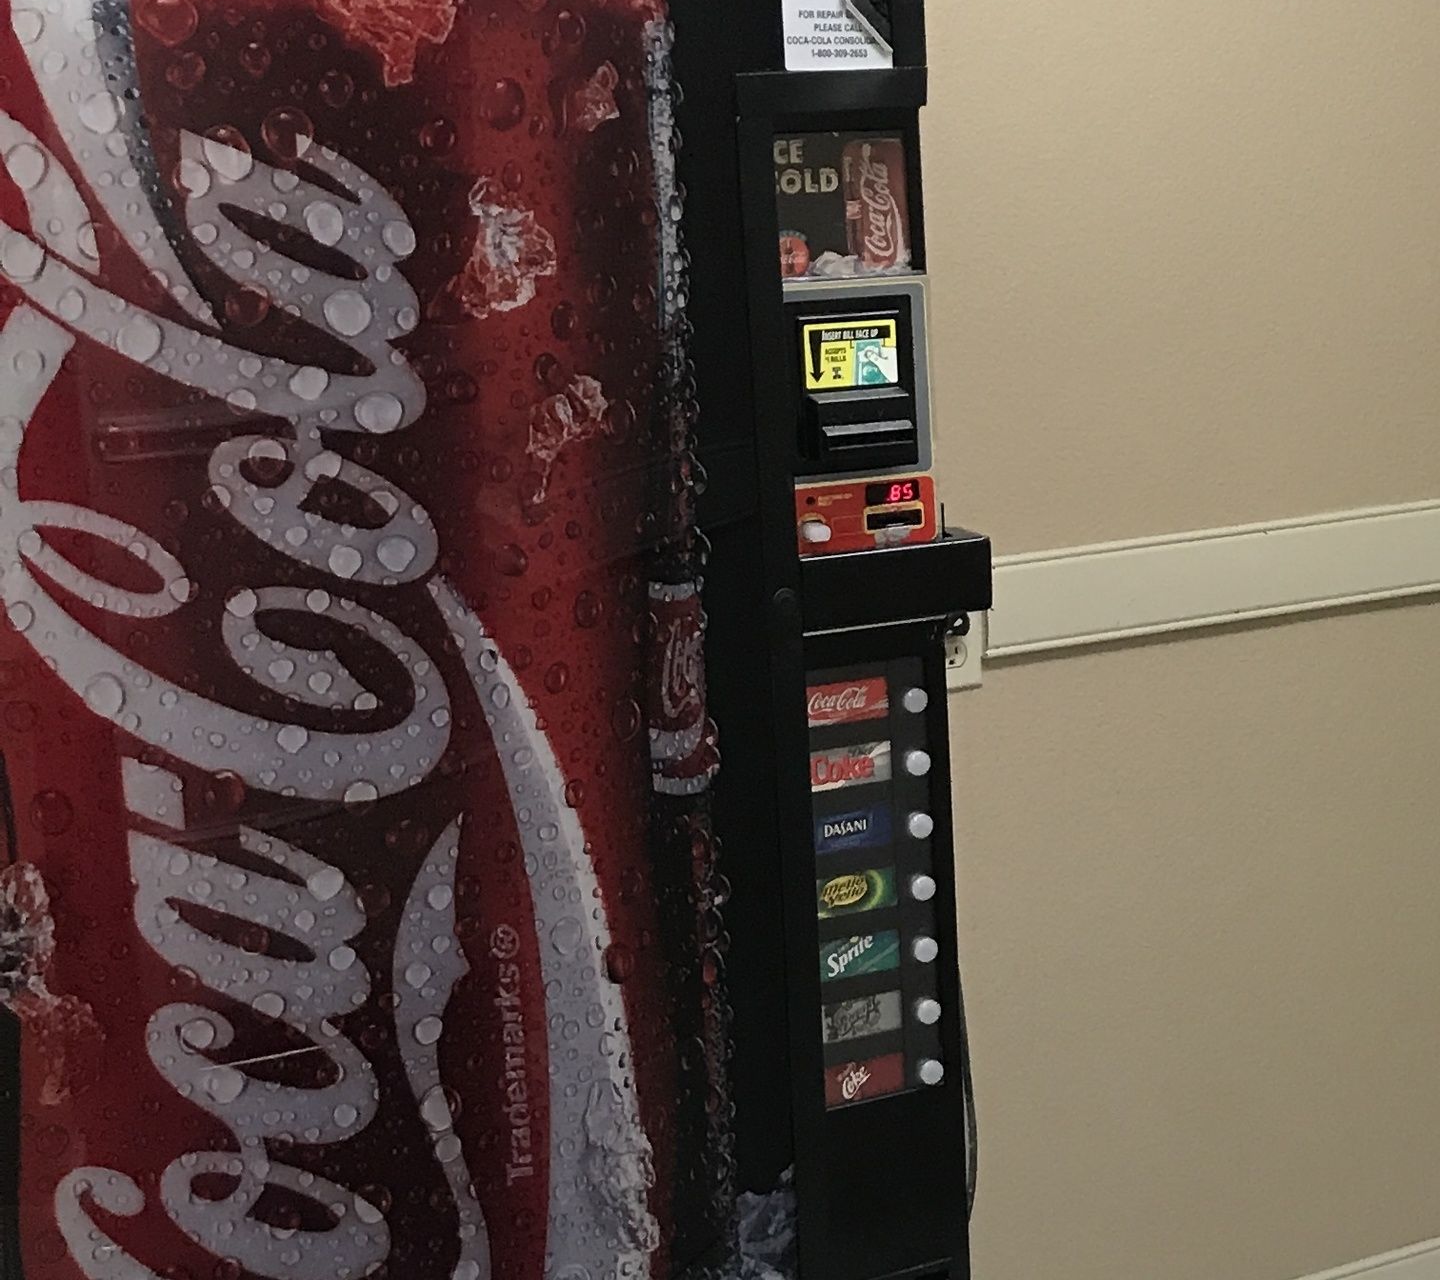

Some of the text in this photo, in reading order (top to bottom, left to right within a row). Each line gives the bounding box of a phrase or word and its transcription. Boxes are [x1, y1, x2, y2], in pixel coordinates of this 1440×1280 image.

[798, 10, 815, 19] FOR
[816, 10, 843, 19] REPAIR
[814, 23, 863, 32] PLEASE CALL
[786, 36, 832, 45] COCA-COLA
[860, 144, 894, 257] Coca-Cola
[821, 328, 879, 341] INSERT BILL FACE UP
[807, 686, 869, 716] Coca-Cola
[810, 754, 875, 785] Coke
[824, 819, 867, 838] DASANI
[827, 934, 874, 978] Sprite
[842, 1066, 872, 1100] Coke
